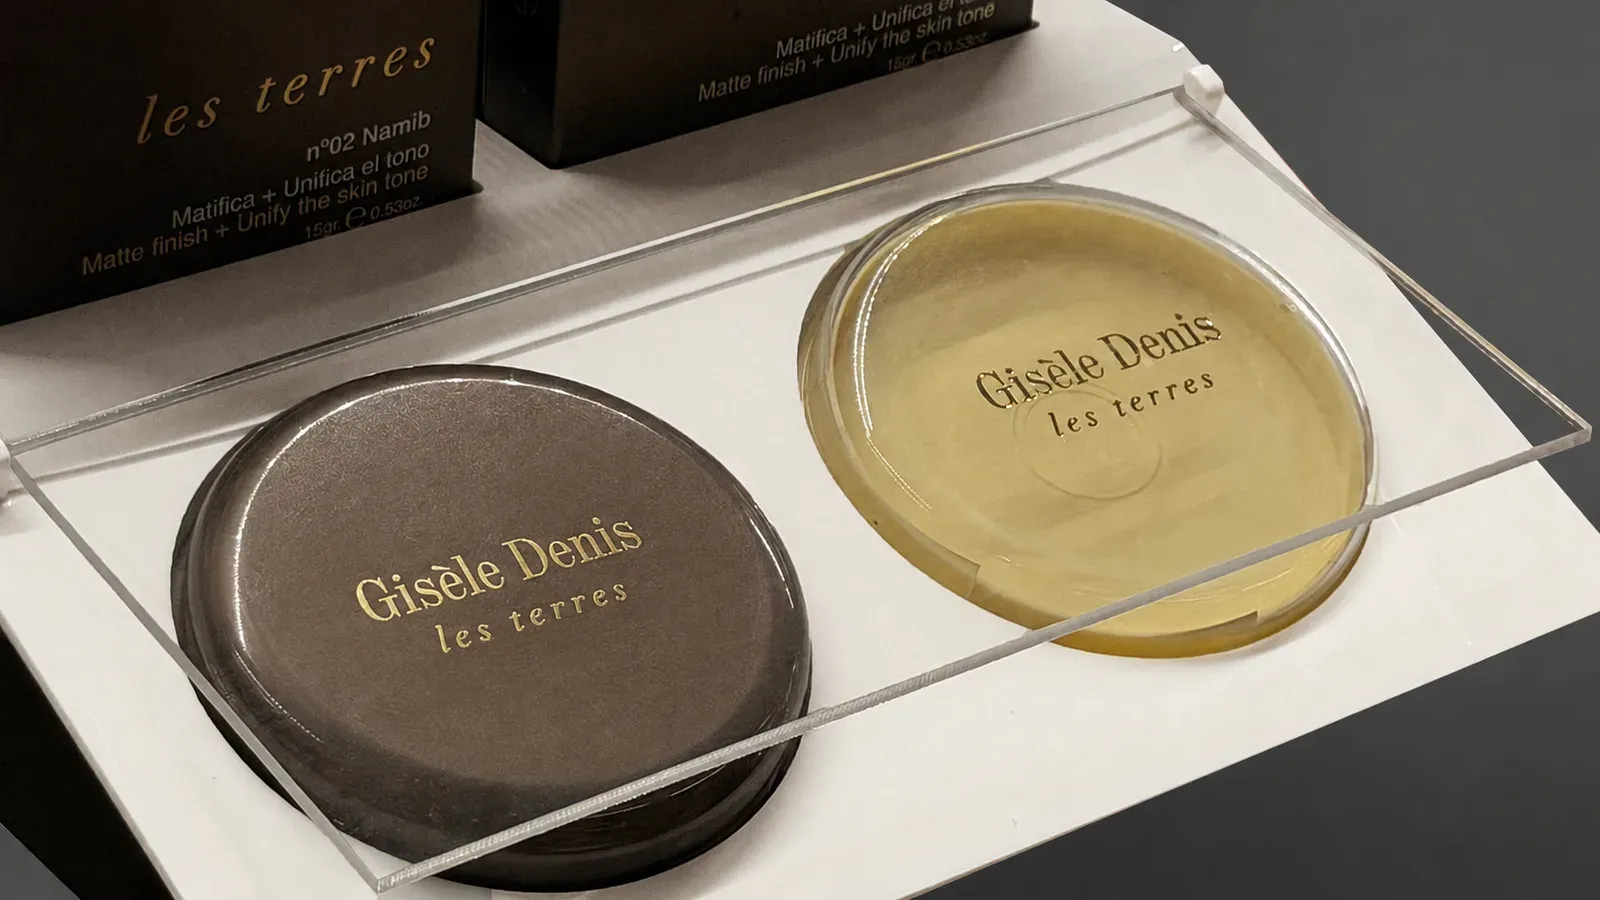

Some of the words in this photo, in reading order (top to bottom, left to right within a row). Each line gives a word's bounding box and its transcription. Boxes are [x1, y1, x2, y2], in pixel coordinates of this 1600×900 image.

[698, 73, 752, 103] Matte
[757, 53, 807, 84] finish
[811, 53, 825, 69] +
[831, 35, 877, 65] Unify
[882, 26, 911, 50] the
[916, 14, 951, 40] skin
[957, 3, 996, 27] tone
[775, 24, 848, 60] Matifica
[853, 21, 867, 36] +
[872, 2, 932, 33] Unifica
[136, 93, 221, 145] les
[256, 36, 436, 114] terres
[362, 110, 431, 146] Namib
[81, 244, 144, 277] Matte
[152, 227, 207, 257] finish
[216, 224, 230, 240] +
[238, 203, 291, 234] Unify
[297, 189, 330, 215] the
[337, 176, 378, 205] skin
[384, 164, 429, 190] tone
[172, 193, 256, 229] Matifica
[262, 187, 277, 204] +
[284, 165, 355, 196] Unifica
[362, 151, 380, 175] el
[385, 142, 431, 168] tono
[976, 349, 1104, 410] Gisèle
[1097, 313, 1222, 370] Denis
[1048, 411, 1099, 438] les
[1113, 373, 1214, 417] terres
[356, 554, 504, 622] Gisèle
[501, 517, 643, 581] Denis
[435, 623, 492, 653] les
[509, 583, 628, 632] terres
